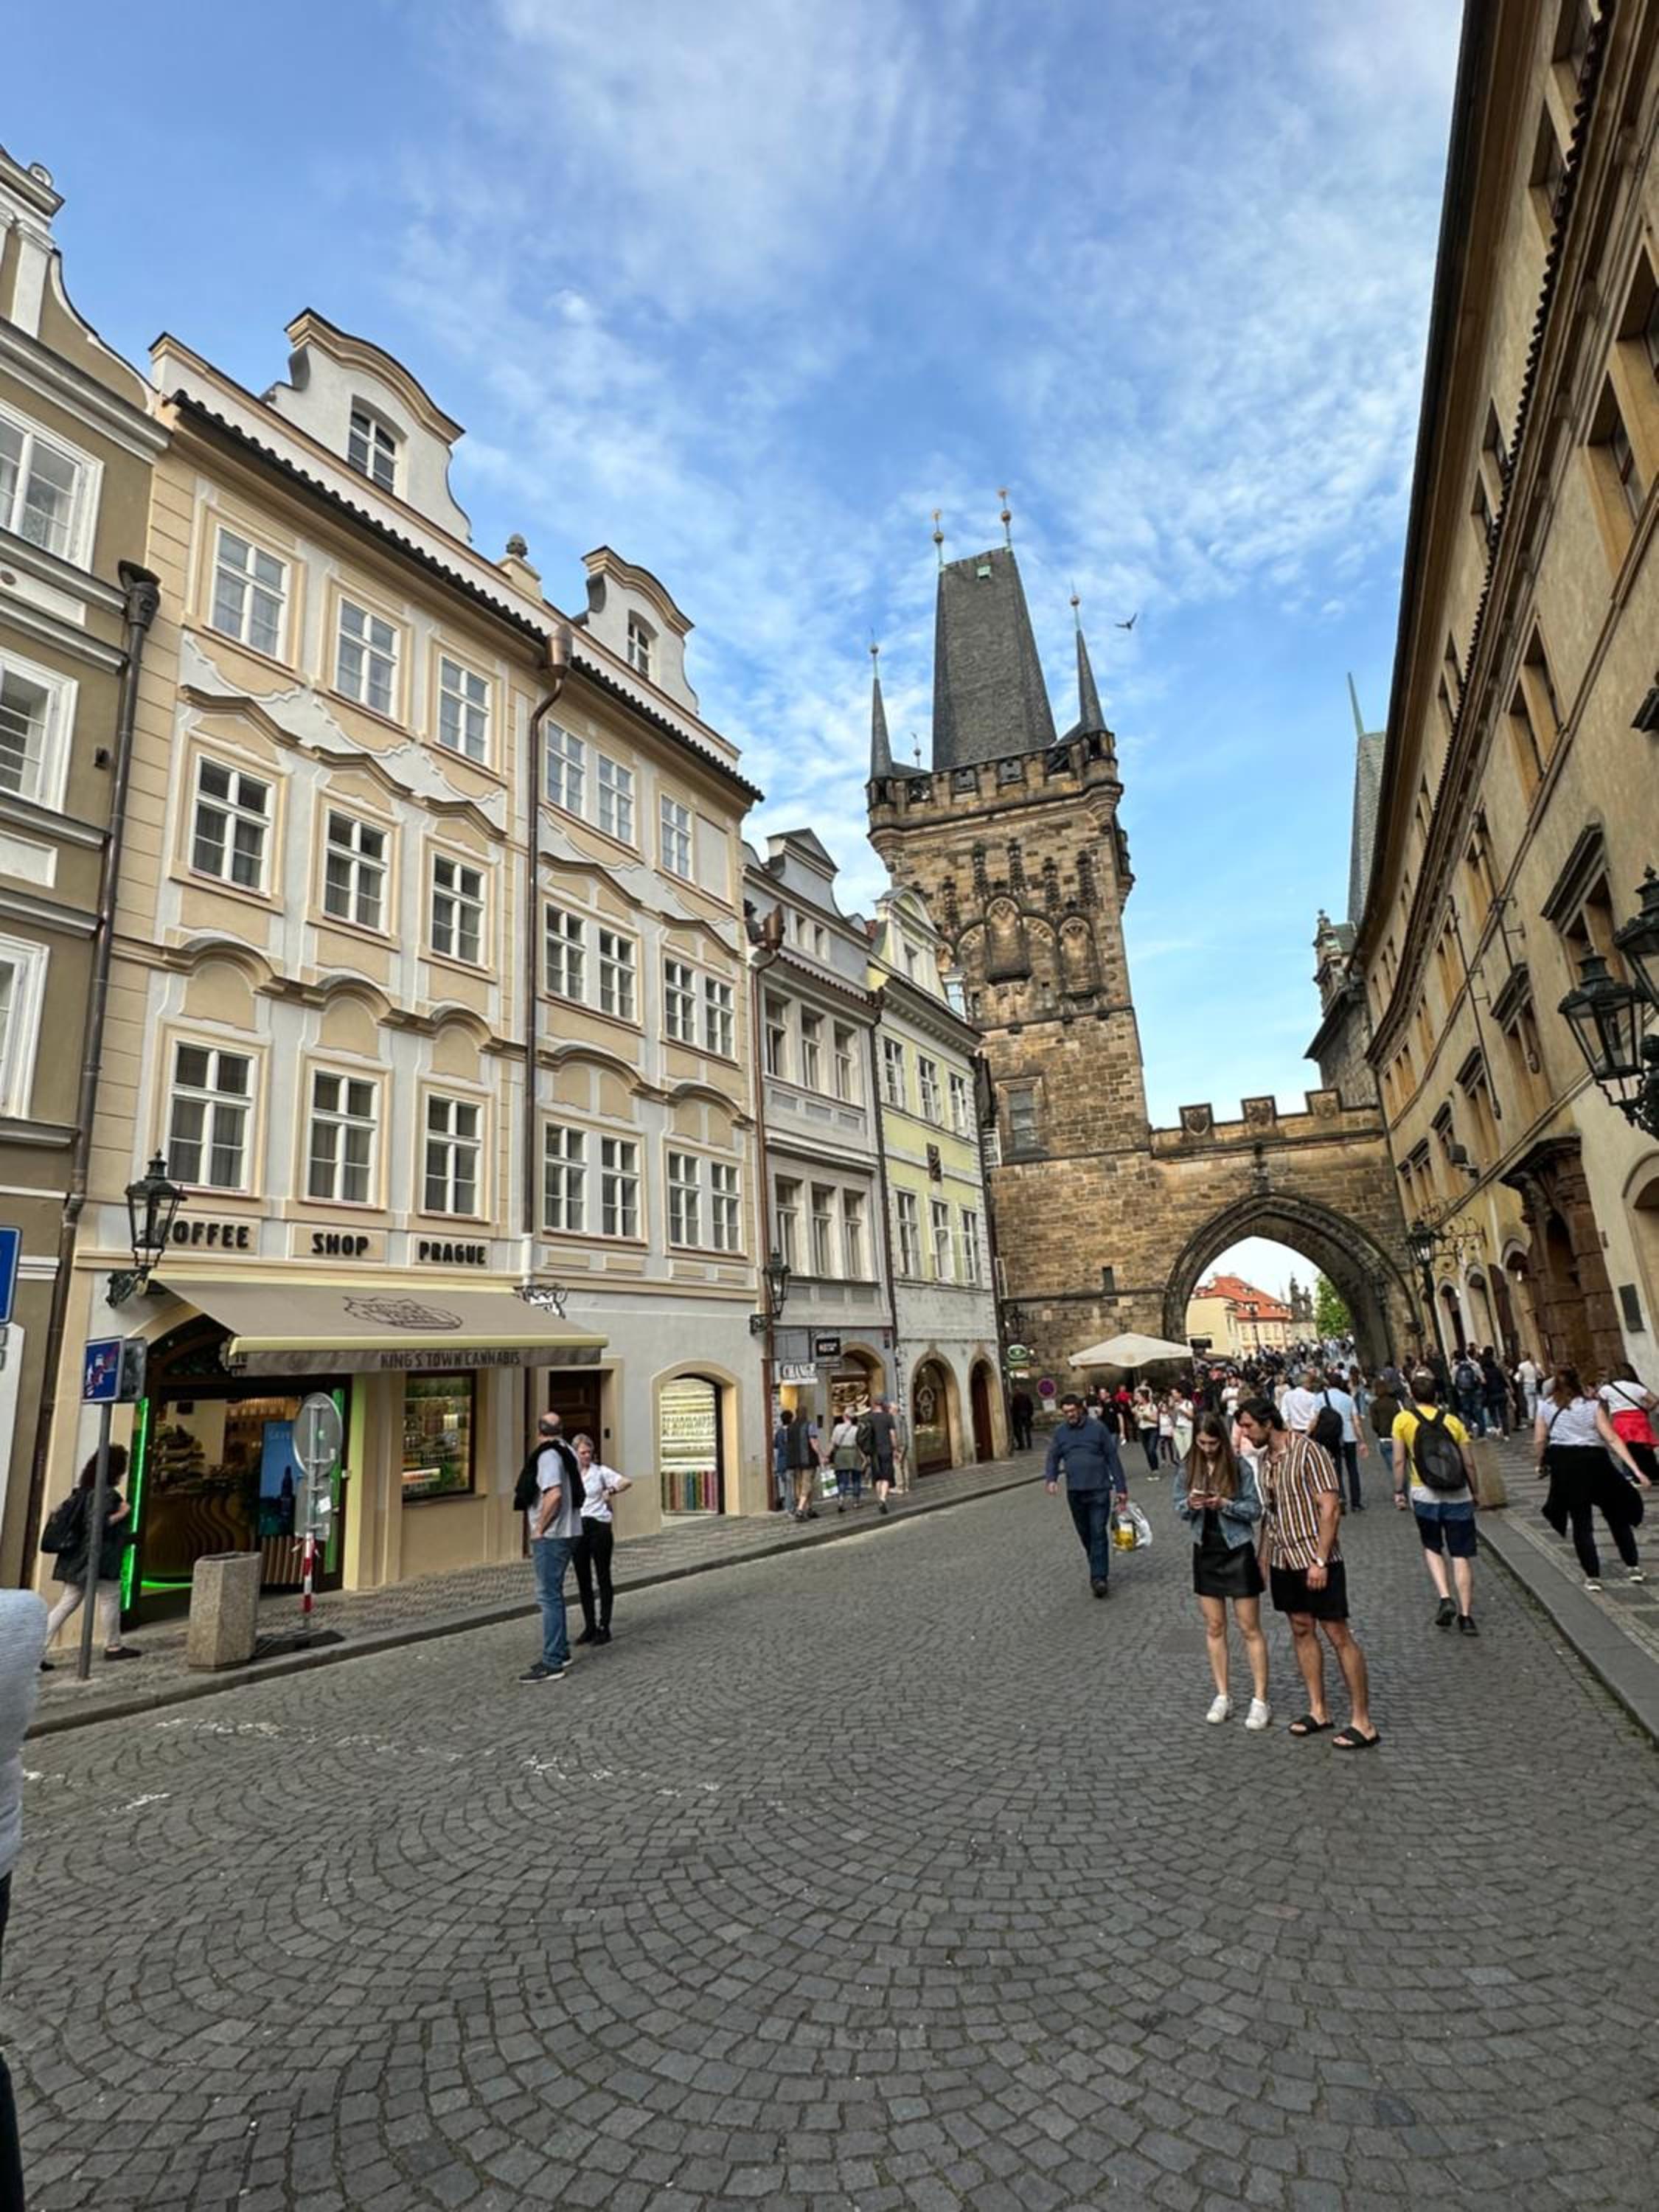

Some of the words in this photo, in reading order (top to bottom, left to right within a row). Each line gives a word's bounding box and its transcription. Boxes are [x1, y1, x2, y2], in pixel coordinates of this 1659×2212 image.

[312, 1233, 369, 1256] SHOP
[419, 1241, 487, 1265] PRAGUE
[426, 1351, 461, 1367] TOWN
[465, 1351, 520, 1366] CANNABIS
